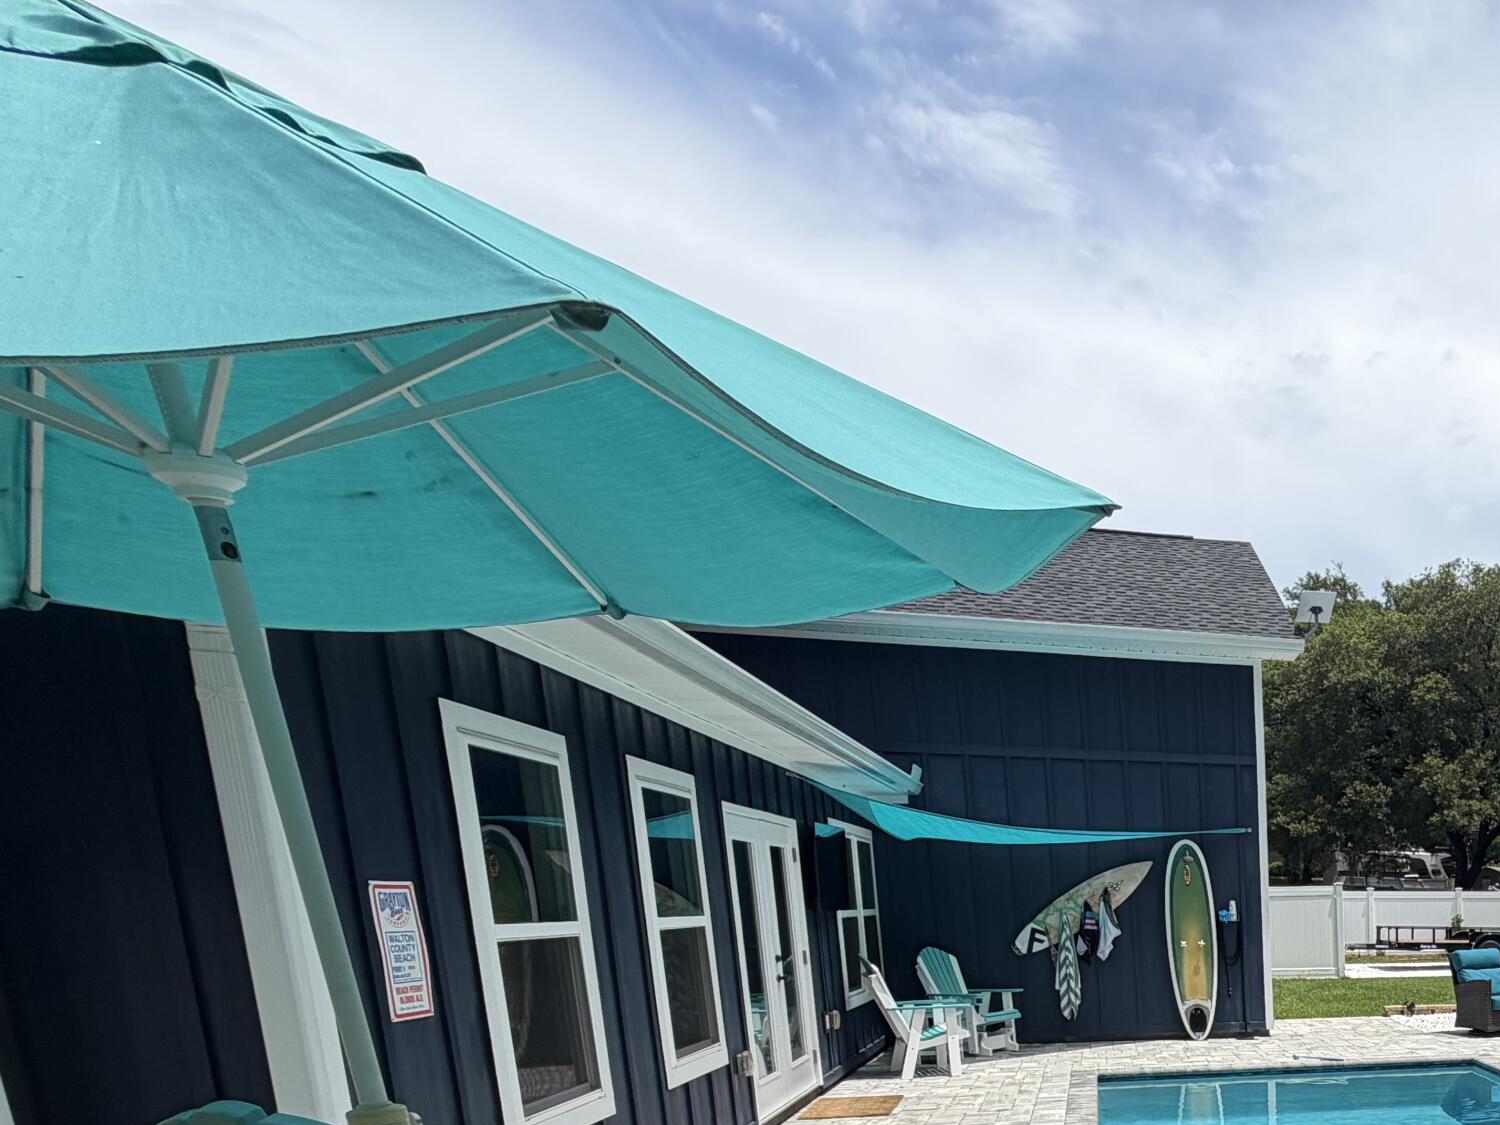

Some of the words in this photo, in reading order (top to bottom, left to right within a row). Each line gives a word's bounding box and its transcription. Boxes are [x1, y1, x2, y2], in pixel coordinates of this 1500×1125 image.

[388, 934, 415, 943] WALTON
[390, 943, 416, 953] COUNTY
[393, 953, 416, 963] BEACH
